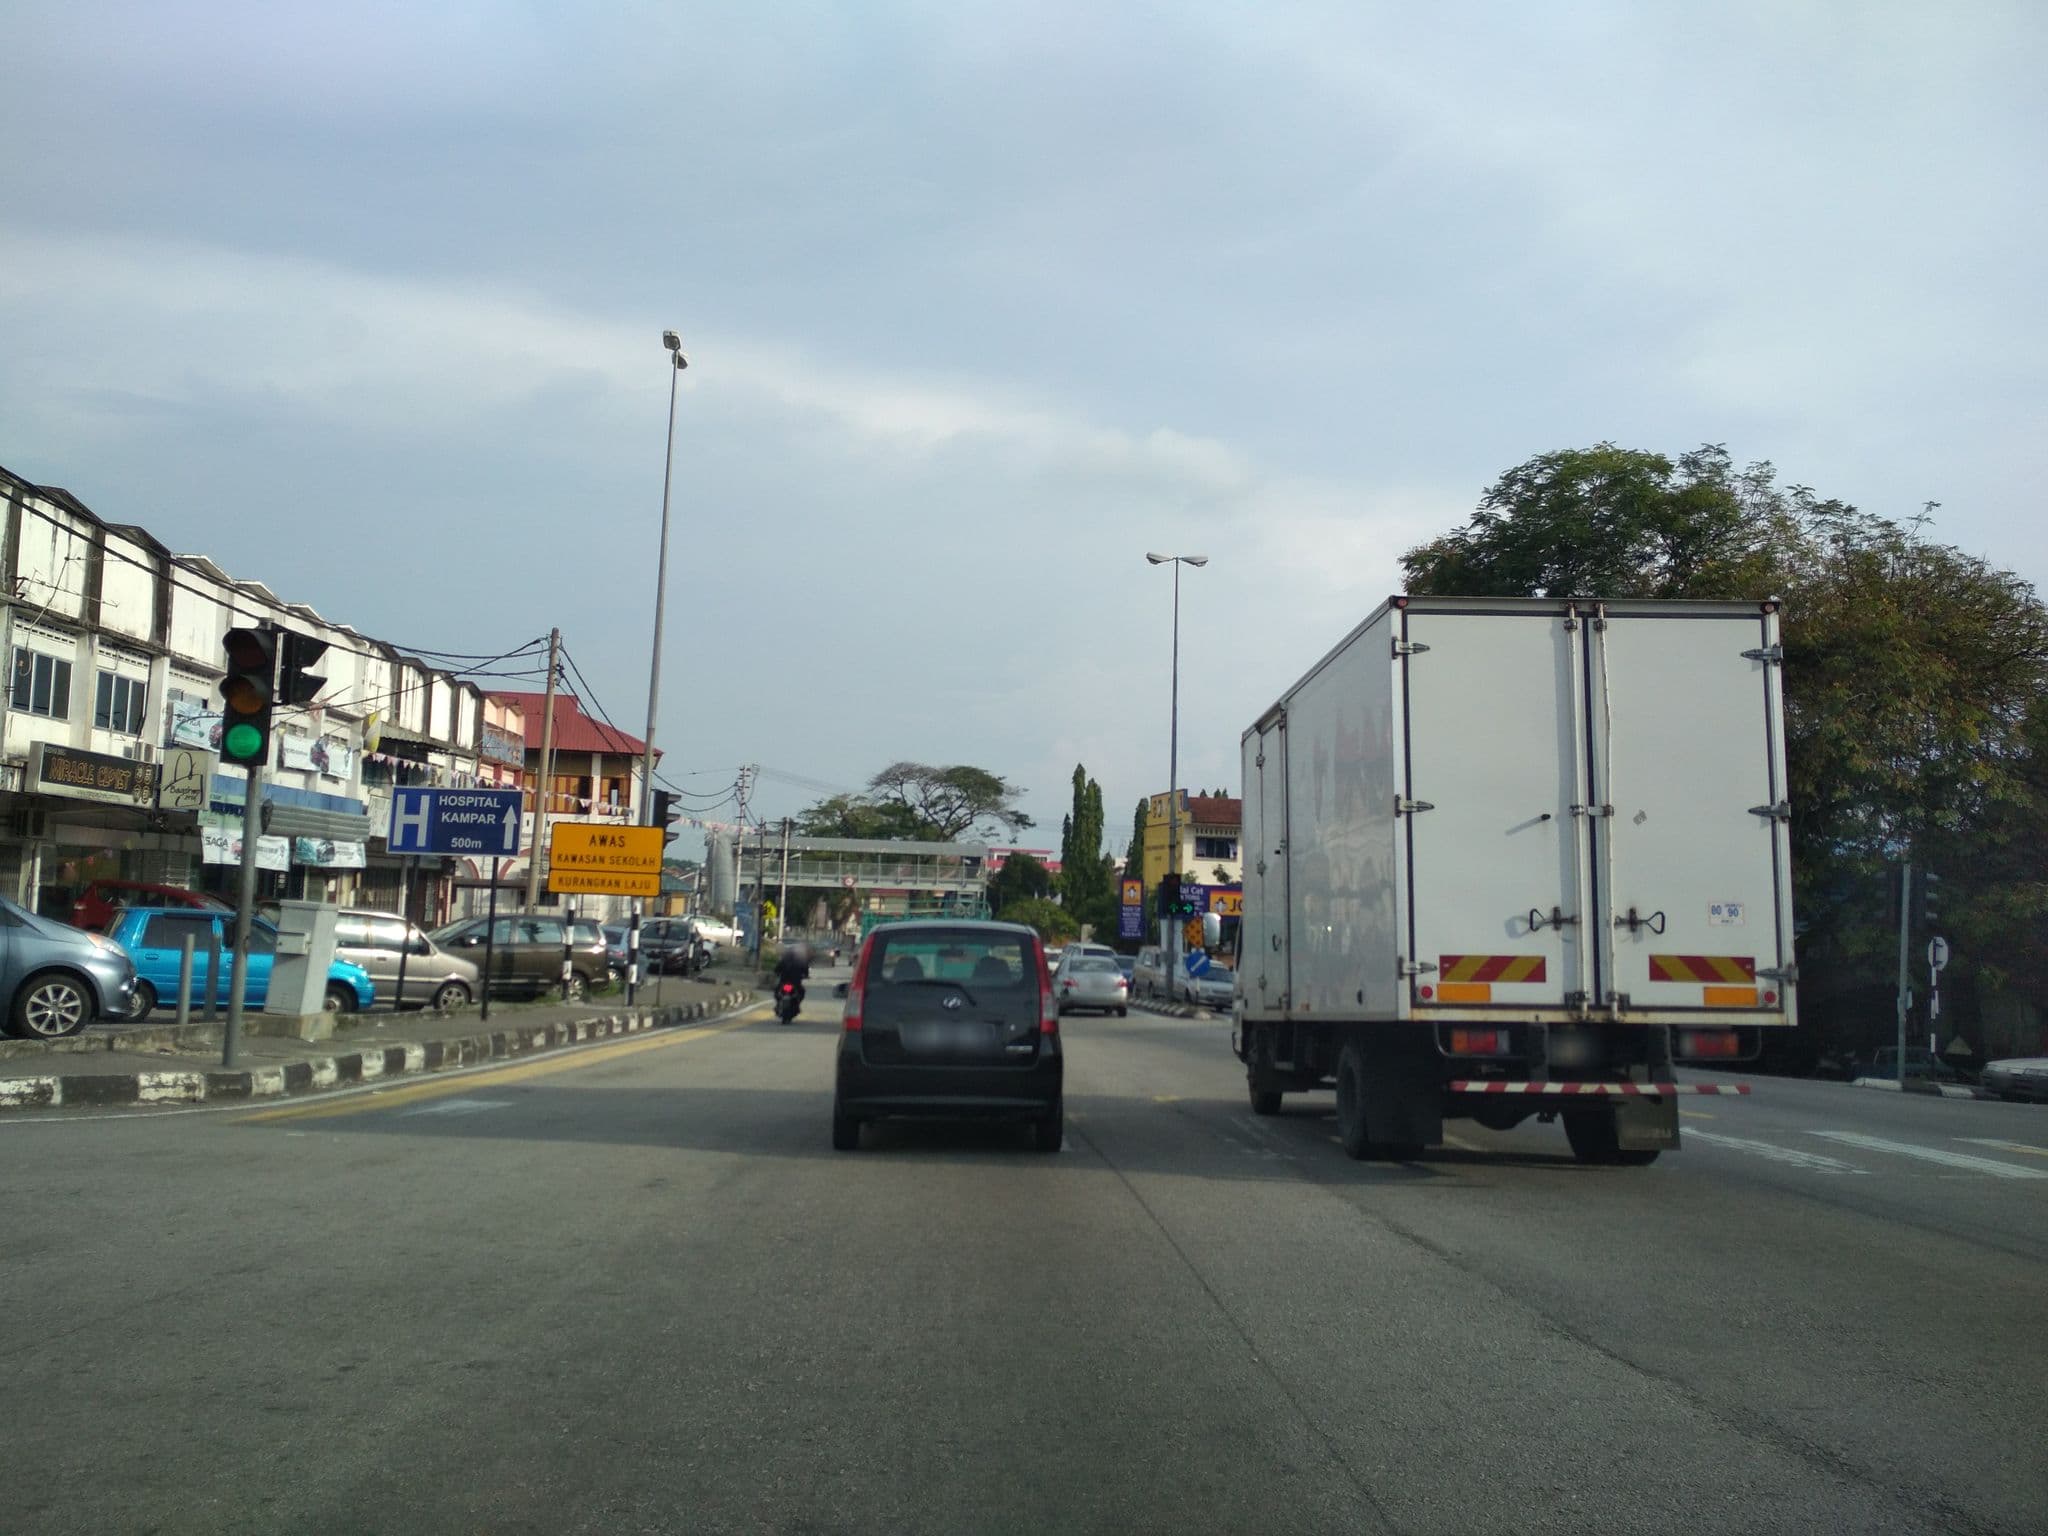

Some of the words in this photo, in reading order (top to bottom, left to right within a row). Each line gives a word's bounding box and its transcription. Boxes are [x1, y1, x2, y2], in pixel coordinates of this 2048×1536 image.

[439, 795, 501, 808] HOSPITAL
[441, 812, 496, 825] KAMPAR
[205, 836, 230, 849] SAGA
[451, 838, 482, 849] 500m
[588, 834, 626, 848] AWAS
[557, 853, 606, 865] KAWASAN
[609, 855, 656, 867] SEKOLAH
[557, 876, 621, 889] KURANGKAN
[623, 879, 651, 890] LAJU
